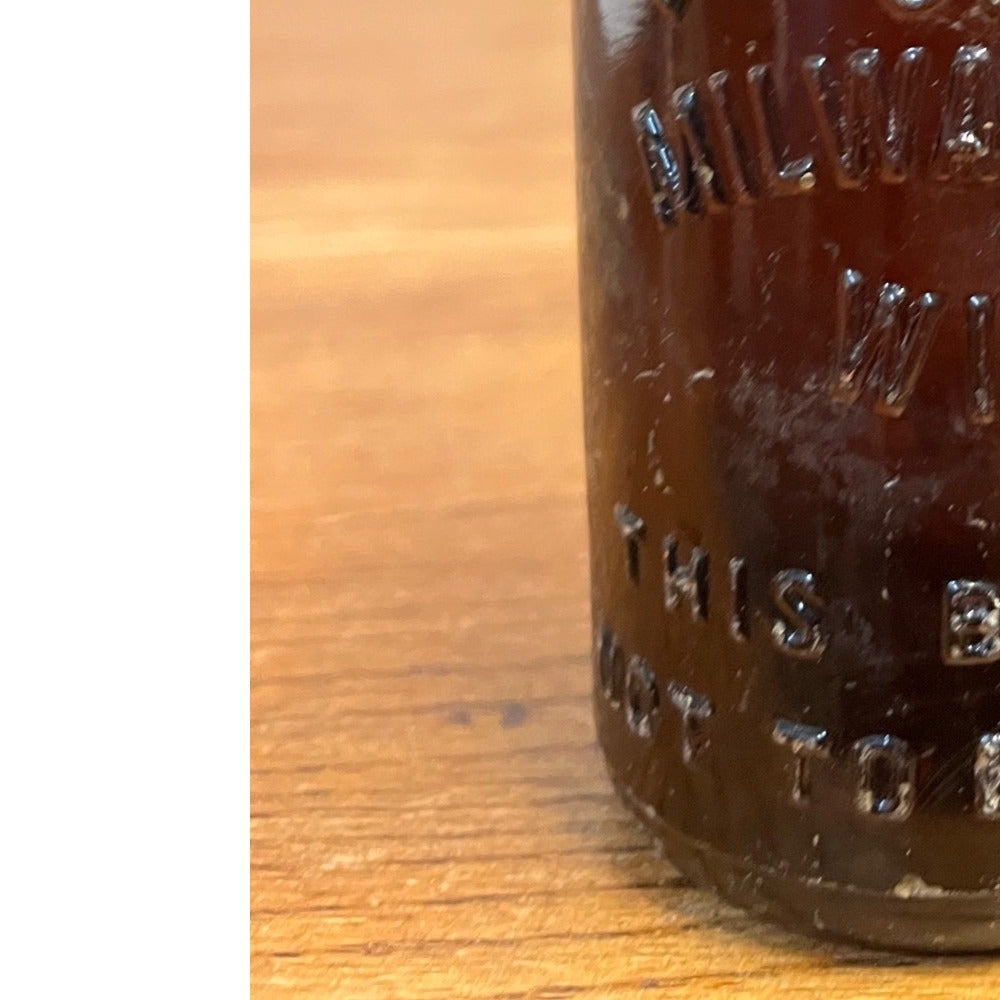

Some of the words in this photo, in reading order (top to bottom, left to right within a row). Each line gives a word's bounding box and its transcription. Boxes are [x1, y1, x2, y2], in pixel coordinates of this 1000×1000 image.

[612, 500, 828, 662] THIS
[596, 618, 714, 768] NOT
[772, 718, 918, 822] TO
